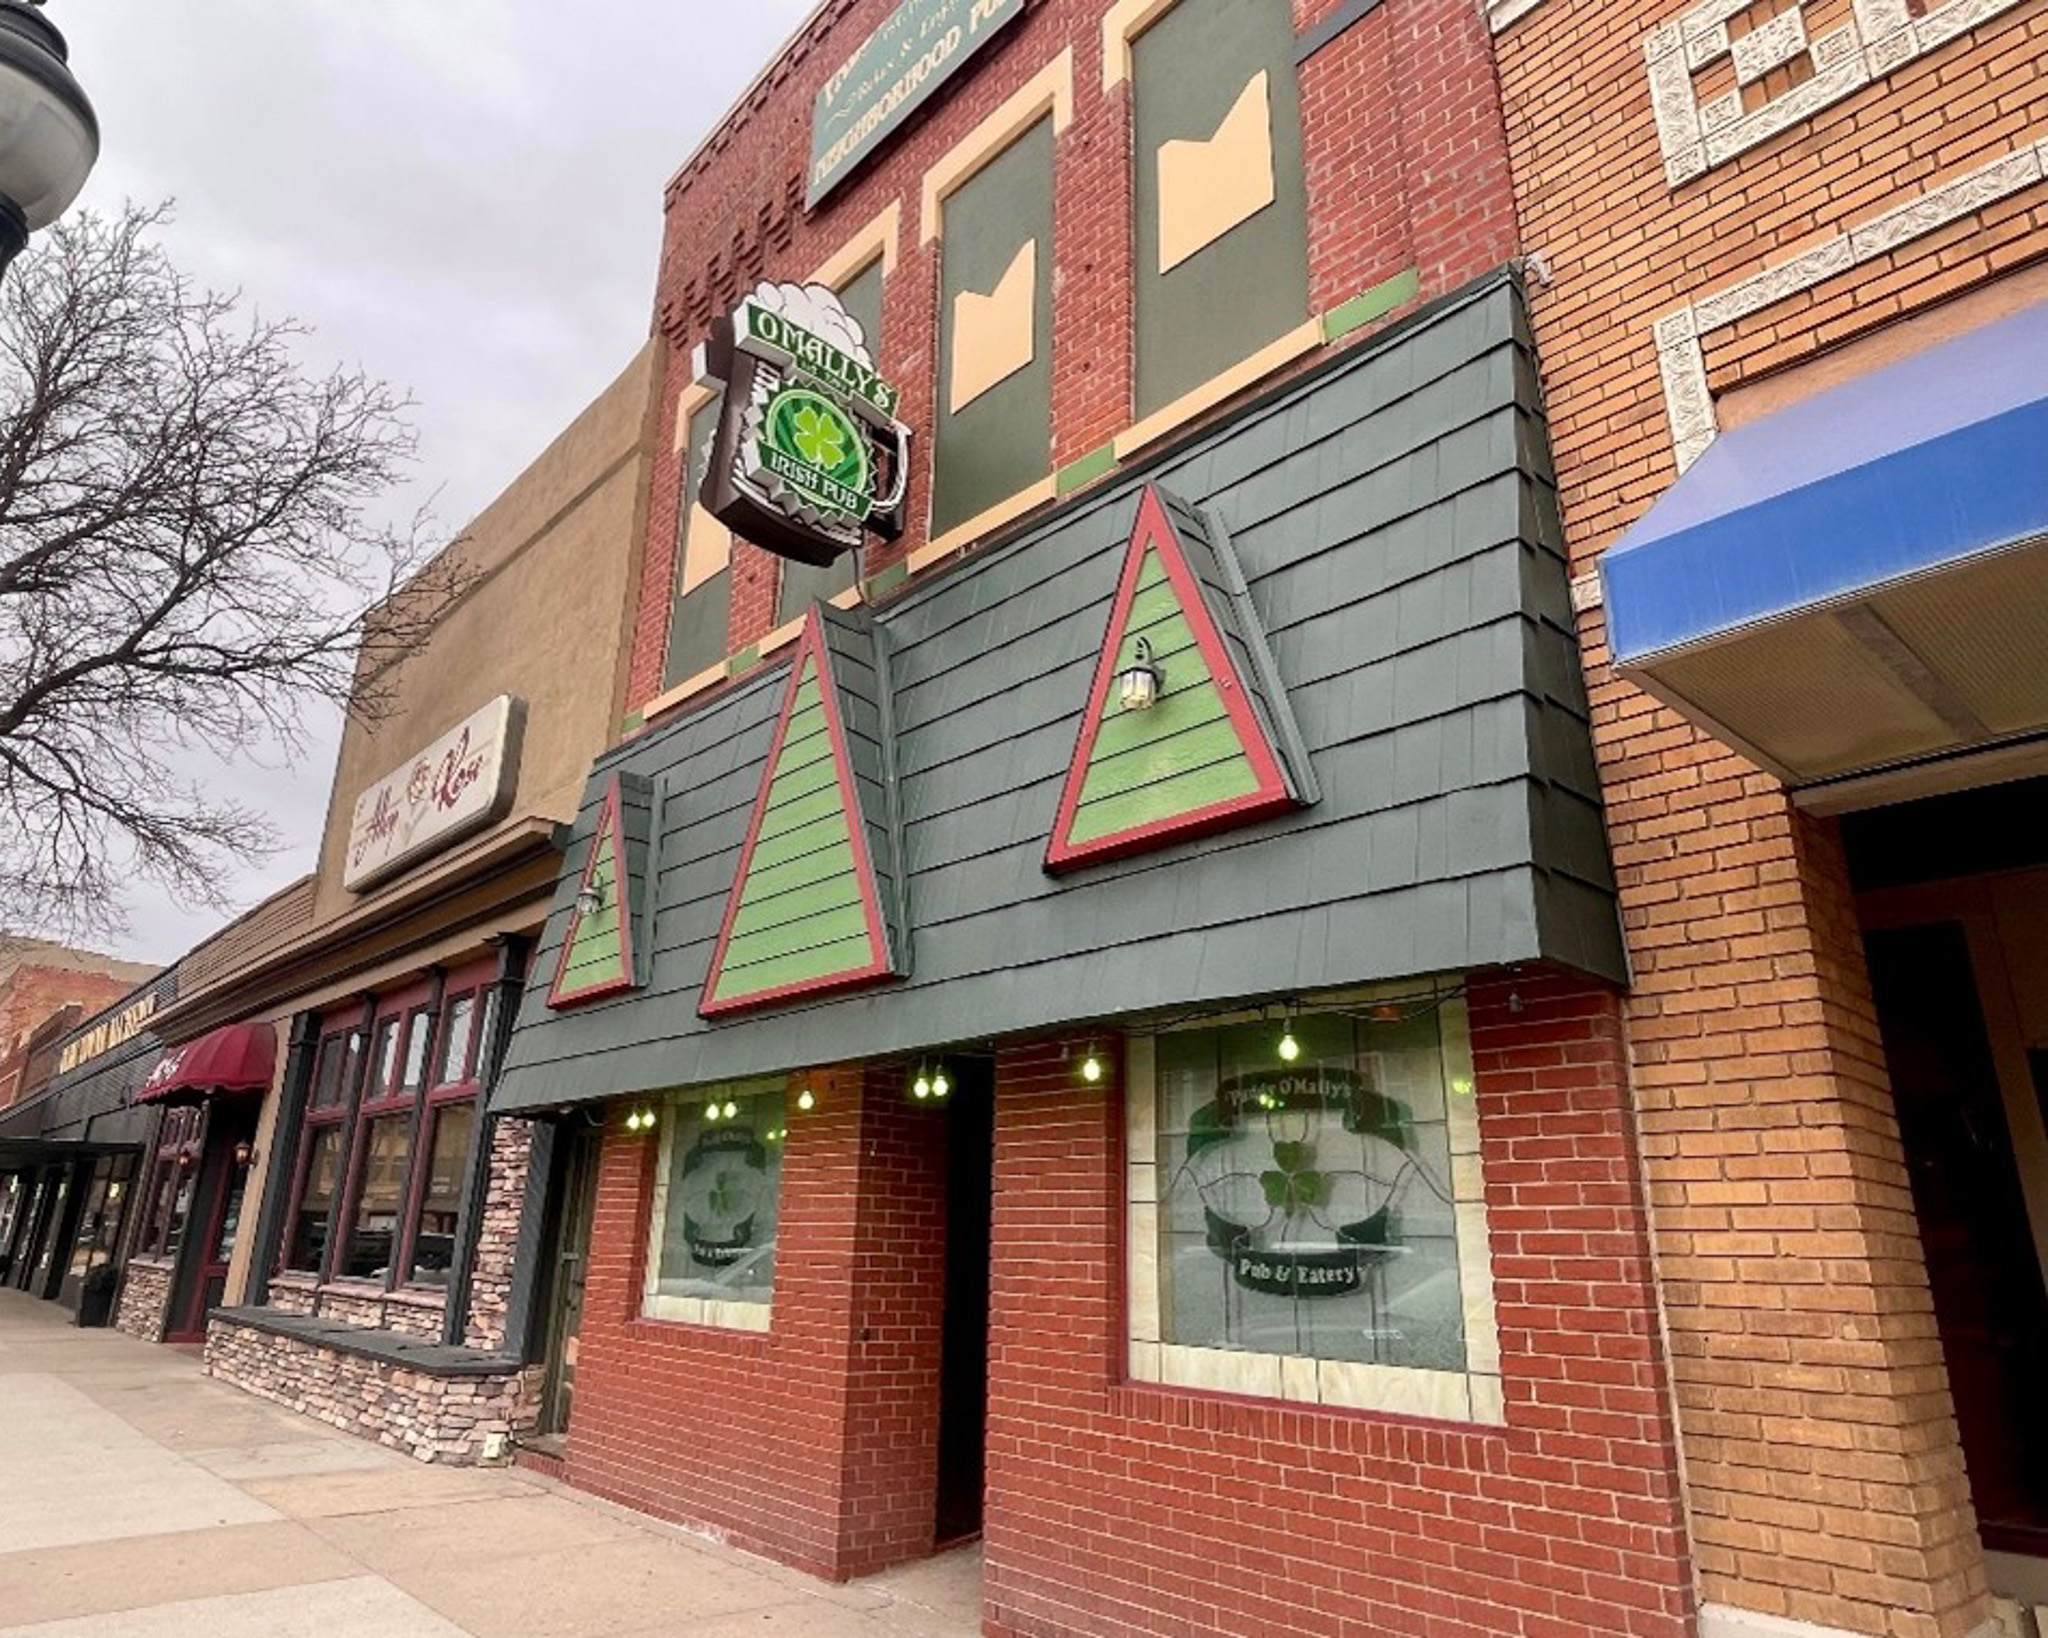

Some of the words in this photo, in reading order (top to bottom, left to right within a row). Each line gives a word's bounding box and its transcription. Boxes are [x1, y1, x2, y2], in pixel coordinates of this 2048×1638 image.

[770, 451, 818, 489] IRISH
[822, 479, 858, 509] PUB
[1240, 1258, 1271, 1280] Pub
[1296, 1265, 1354, 1284] Eatery
